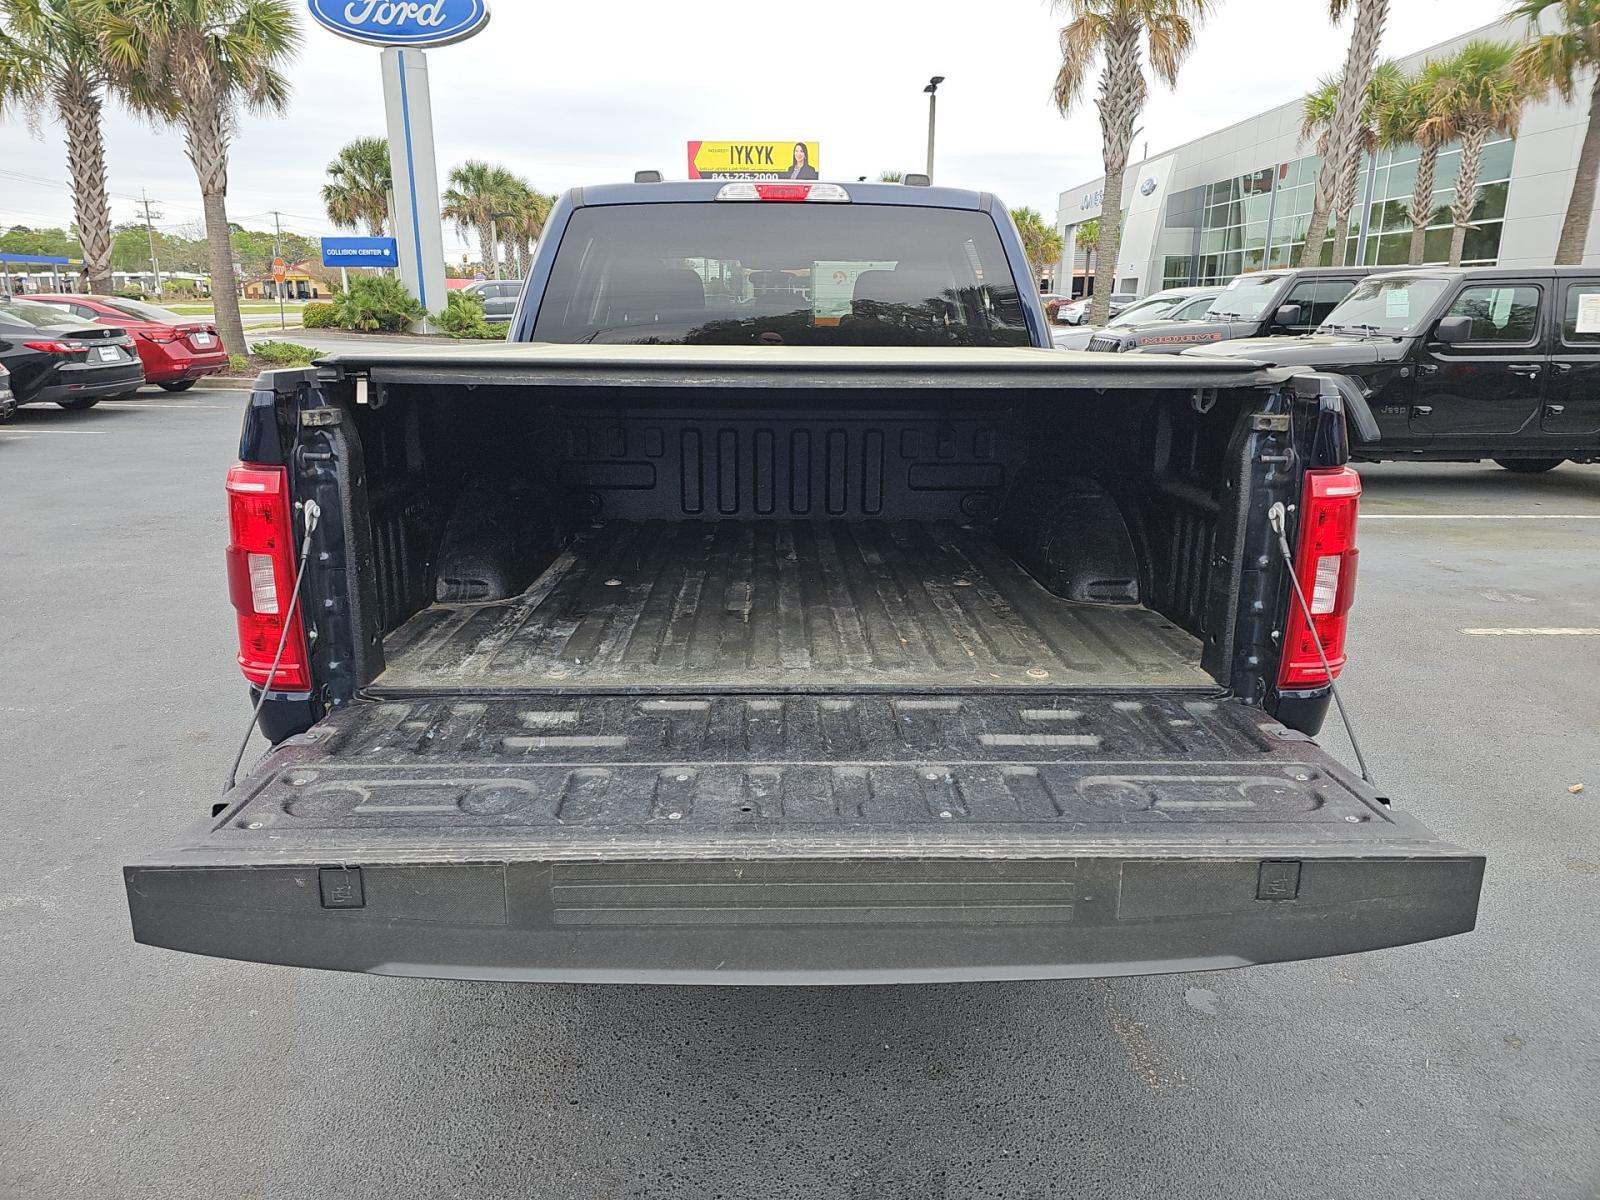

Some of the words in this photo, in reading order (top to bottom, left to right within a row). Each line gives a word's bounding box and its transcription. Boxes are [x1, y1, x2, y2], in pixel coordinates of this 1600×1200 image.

[344, 0, 446, 26] Ford
[730, 145, 774, 165] IYKYK
[326, 248, 358, 256] COLLISION
[358, 248, 382, 256] CENTER
[1141, 332, 1222, 345] MOJAVE
[1380, 405, 1406, 414] Jeep
